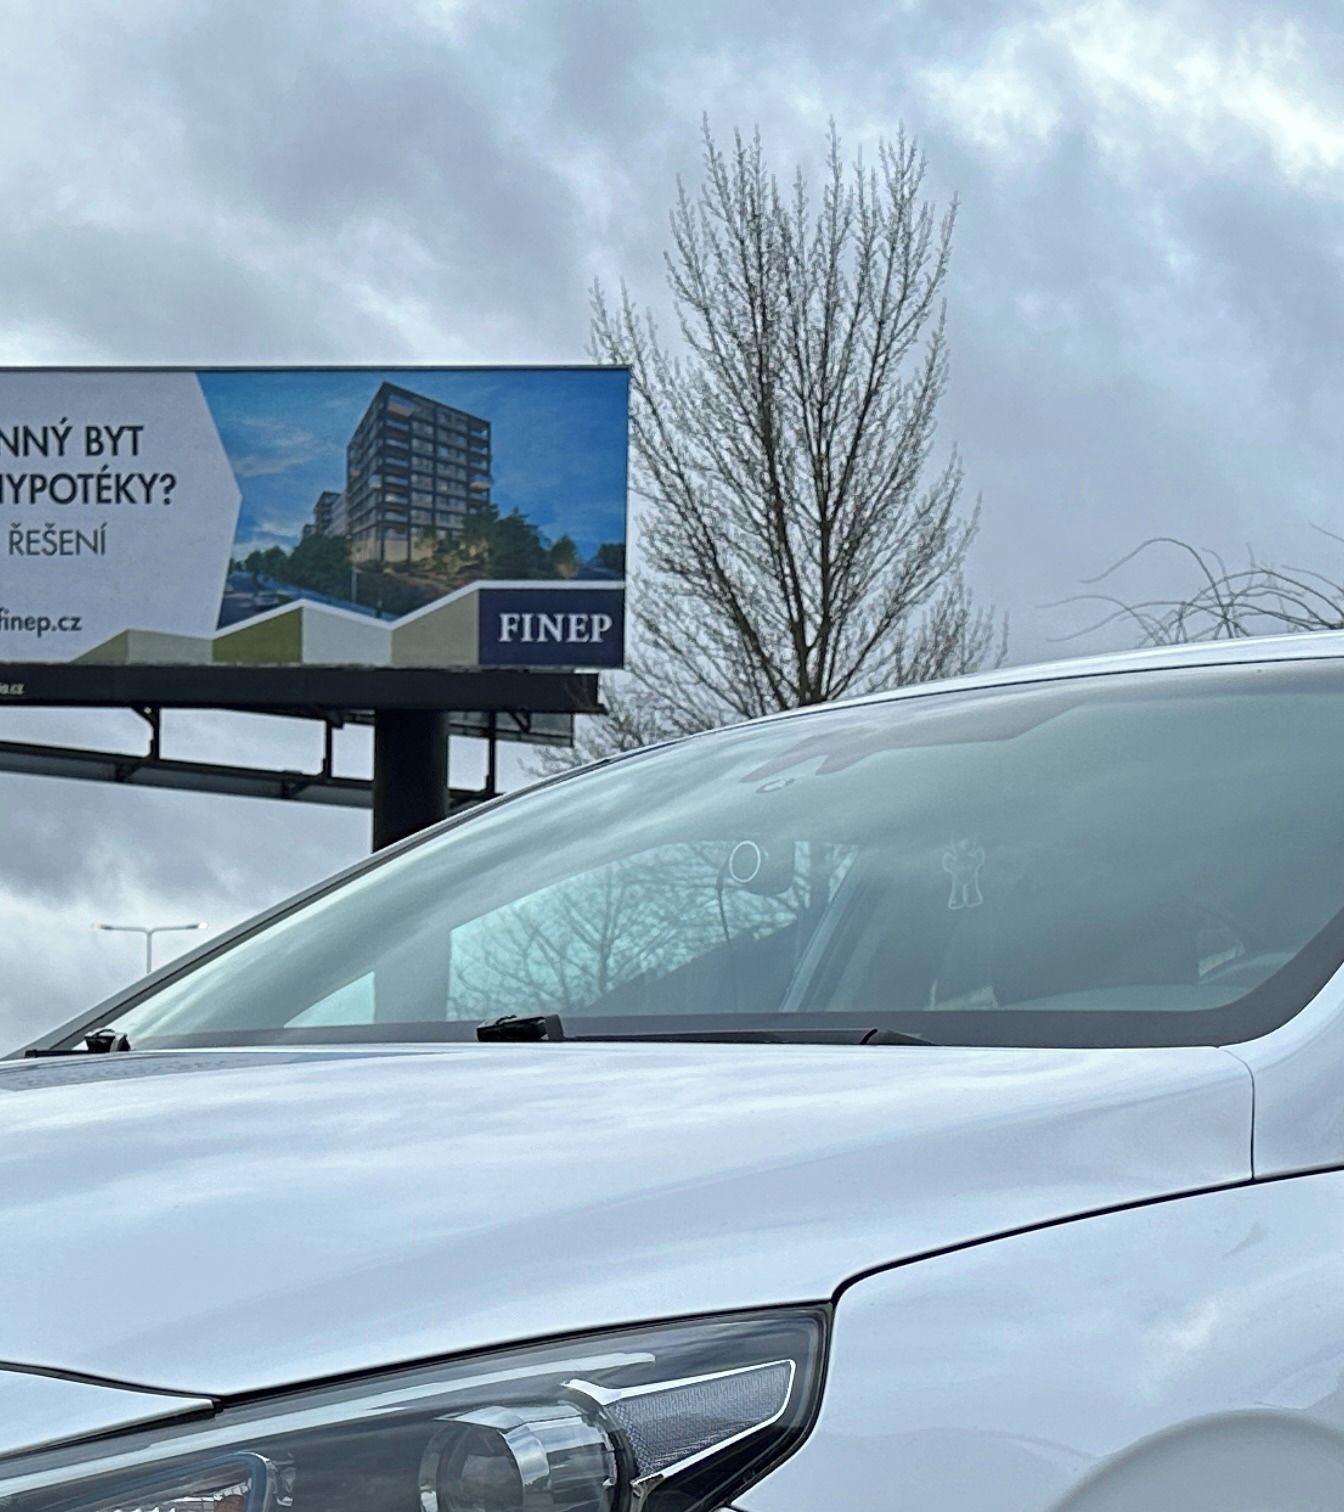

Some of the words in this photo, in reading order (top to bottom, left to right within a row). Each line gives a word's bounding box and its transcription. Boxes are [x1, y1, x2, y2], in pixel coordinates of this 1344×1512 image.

[85, 425, 144, 457] BYT
[9, 522, 108, 556] ŘEŠENÍ
[498, 612, 614, 645] FINEP
